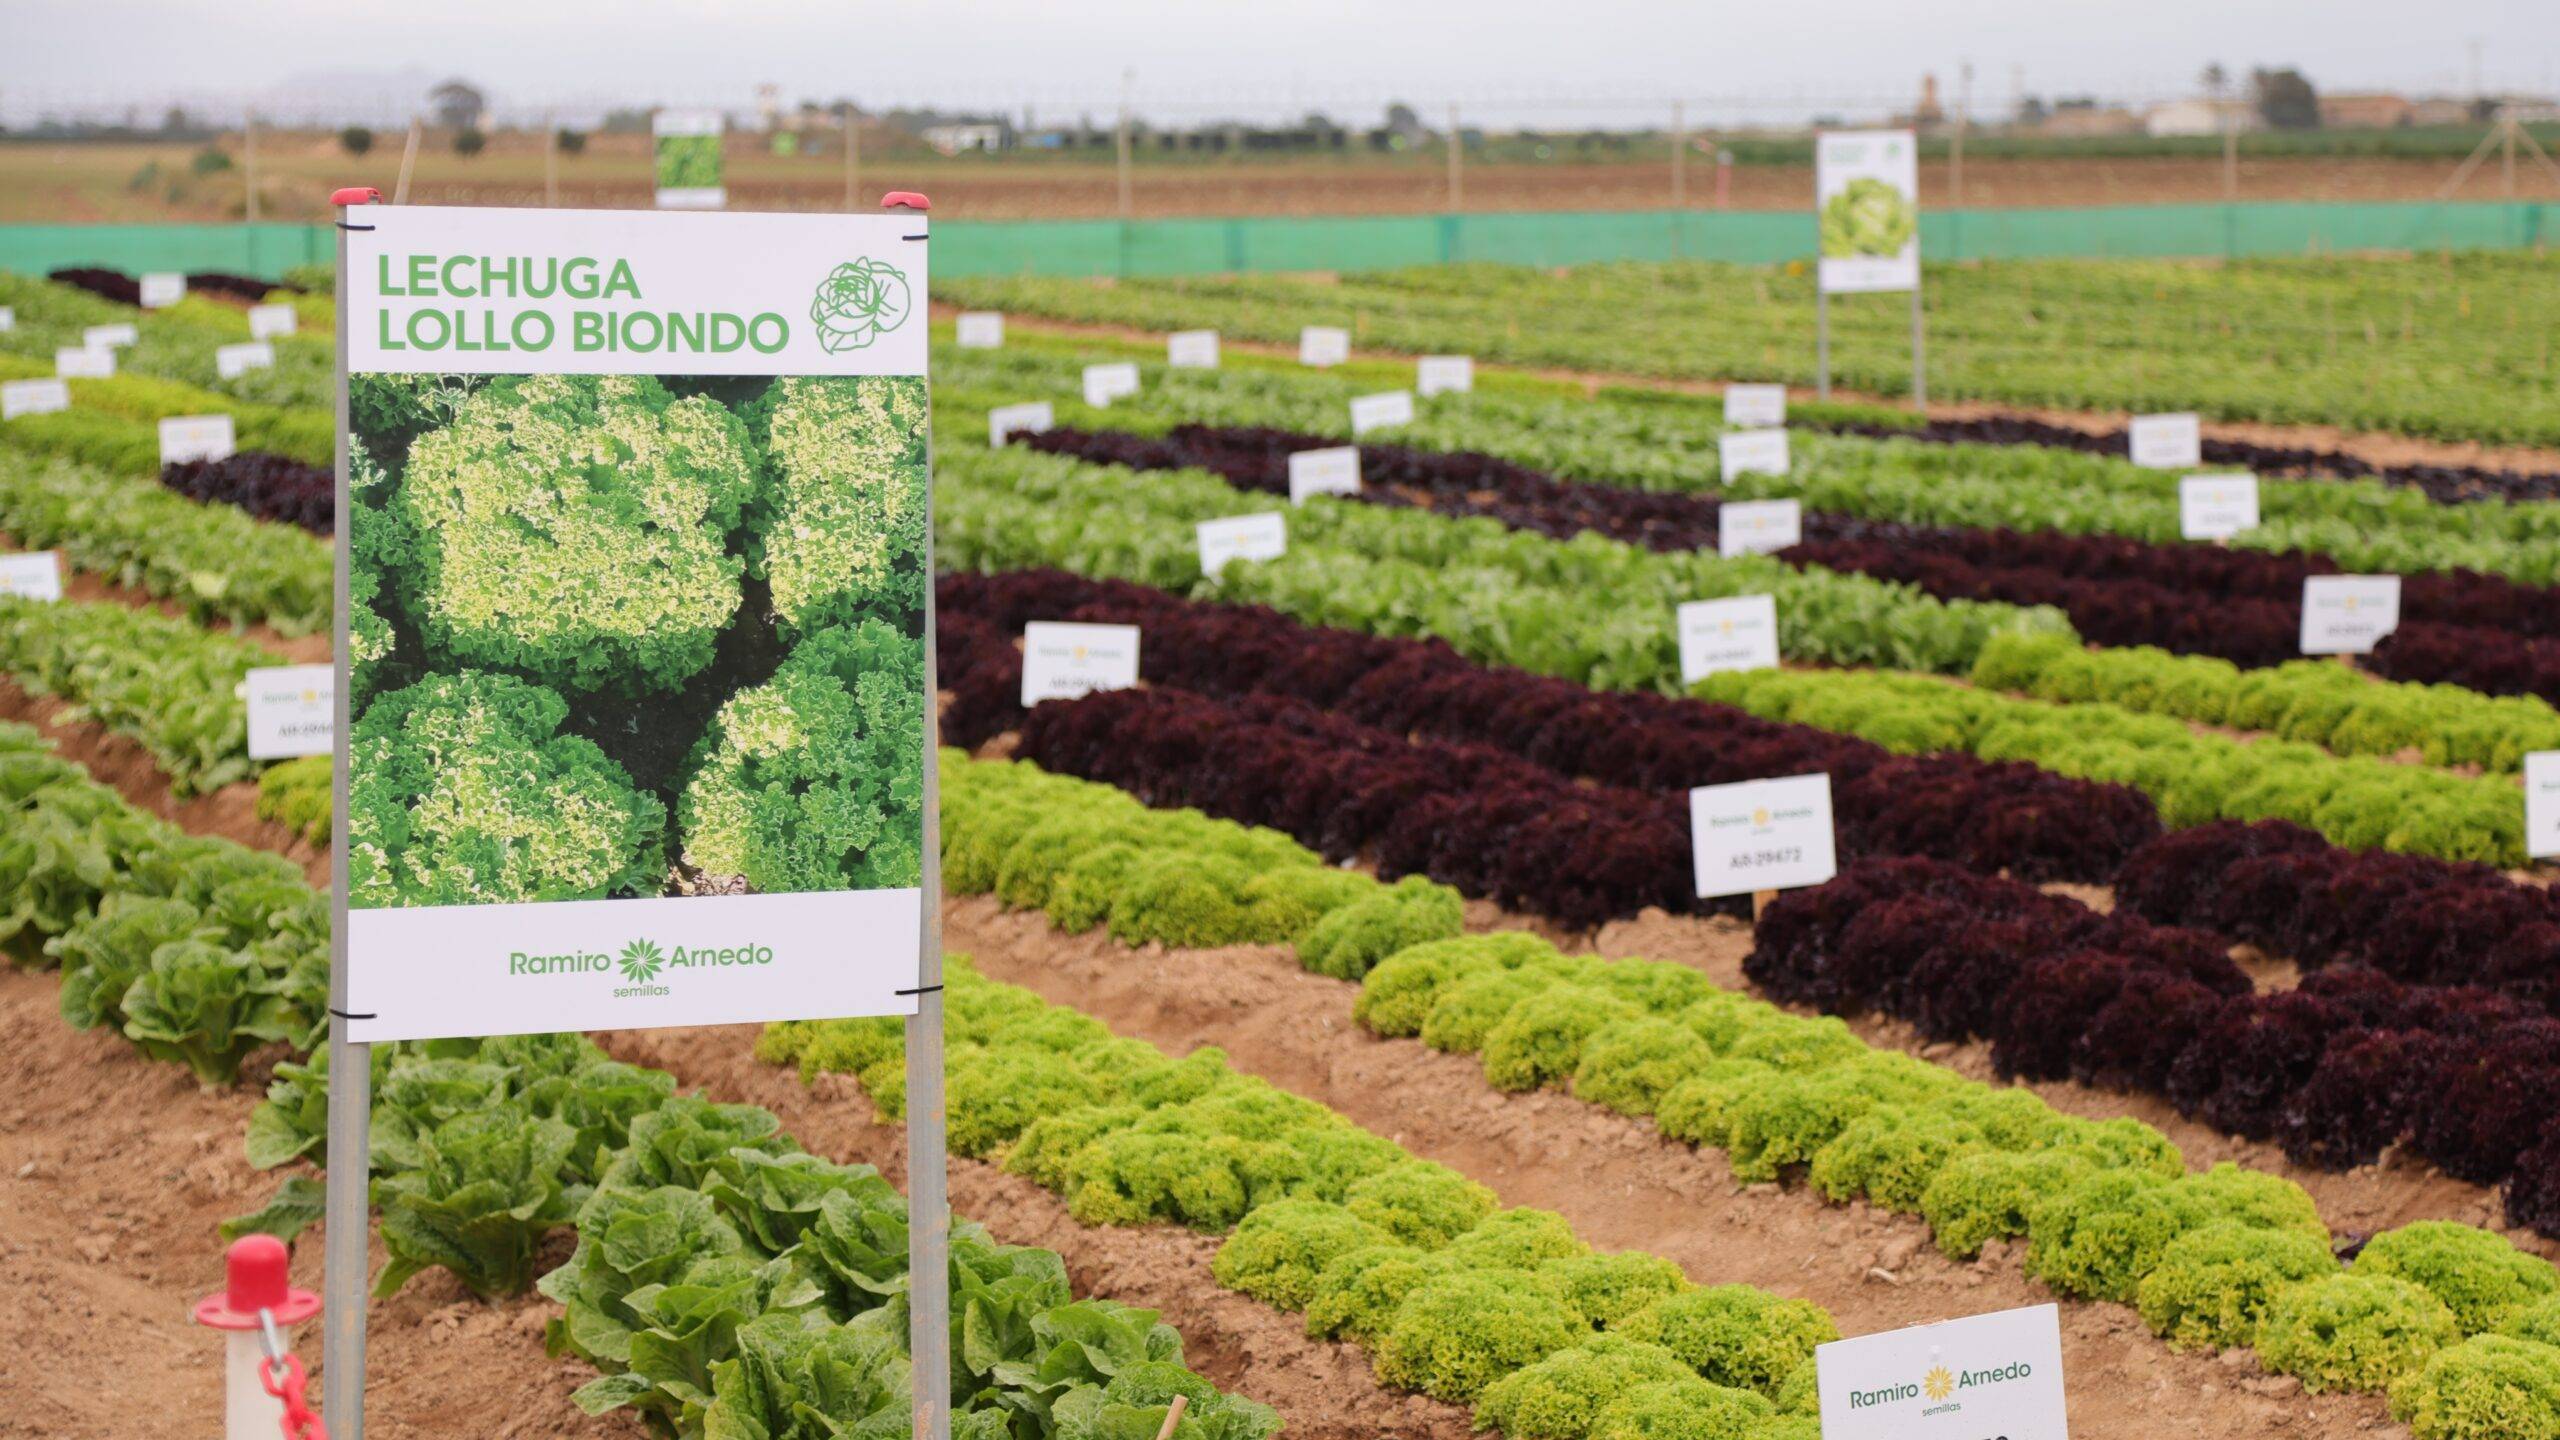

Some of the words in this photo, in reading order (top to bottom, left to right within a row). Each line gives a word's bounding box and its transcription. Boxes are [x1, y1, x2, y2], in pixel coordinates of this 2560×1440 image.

[379, 253, 643, 299] LECHUGA
[378, 308, 556, 352] LOLLO
[573, 311, 791, 354] BIONDO
[509, 950, 612, 976] Ramiro
[668, 942, 774, 969] Arnedo
[612, 984, 671, 998] semillas
[1849, 1383, 1919, 1409] Ramiro
[1958, 1361, 2032, 1389] Arnedo
[1921, 1402, 1962, 1417] semillas
